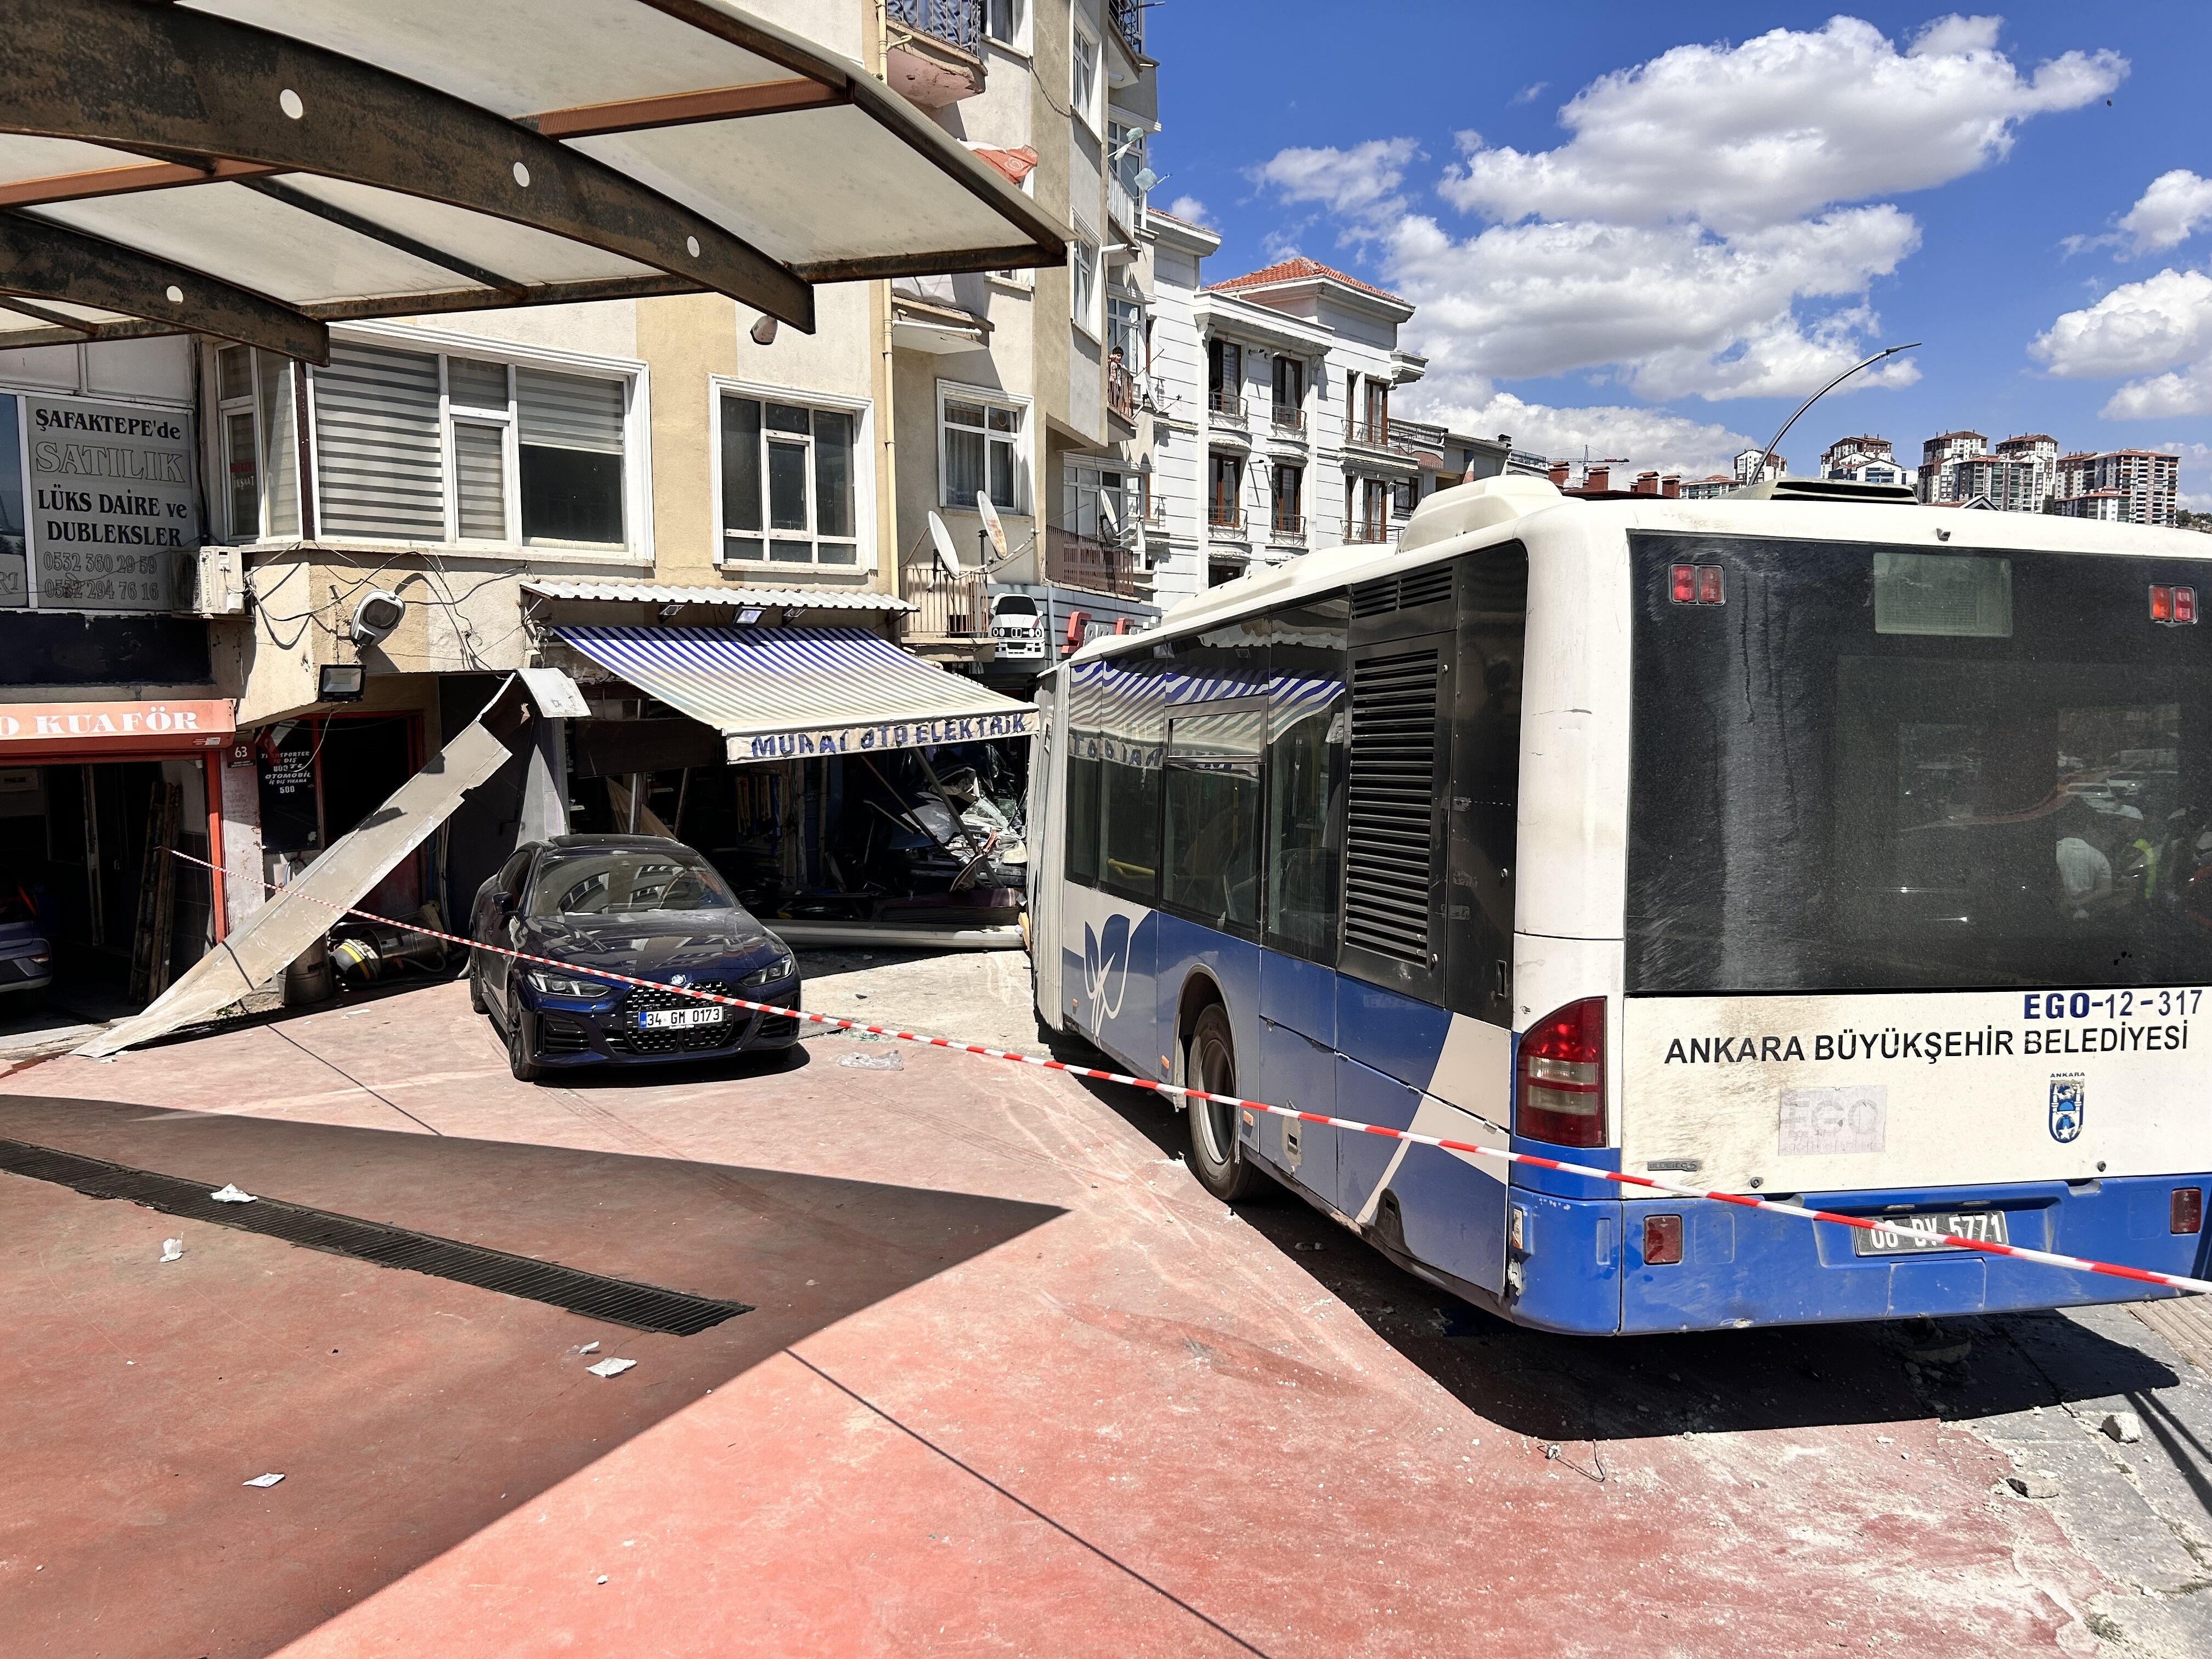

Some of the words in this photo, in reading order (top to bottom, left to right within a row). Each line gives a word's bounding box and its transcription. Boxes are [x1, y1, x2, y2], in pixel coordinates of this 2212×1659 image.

[35, 408, 181, 439] ŞAFAKTEPE'de
[36, 441, 186, 483] SATILIK
[37, 483, 92, 512] LÜKS
[99, 488, 160, 517] DAİRE
[165, 501, 188, 519] ve
[47, 520, 182, 548] DUBLEKSLER
[43, 551, 81, 572] 0532
[86, 552, 113, 573] 360
[116, 554, 136, 574] 29
[139, 555, 157, 574] 59
[119, 581, 137, 600] 76
[141, 582, 159, 601] 16
[33, 706, 200, 735] KUAFÖR
[235, 746, 248, 758] 63
[265, 771, 311, 779] OTOMOBİL
[279, 786, 295, 794] 500
[647, 1013, 662, 1026] 34
[671, 1011, 685, 1024] GM
[692, 1008, 720, 1023] 0173
[1664, 1036, 1805, 1063] ANKARA
[1815, 1025, 2014, 1064] BÜYÜKŞEHİR
[2024, 1019, 2188, 1054] BELEDİYESİ
